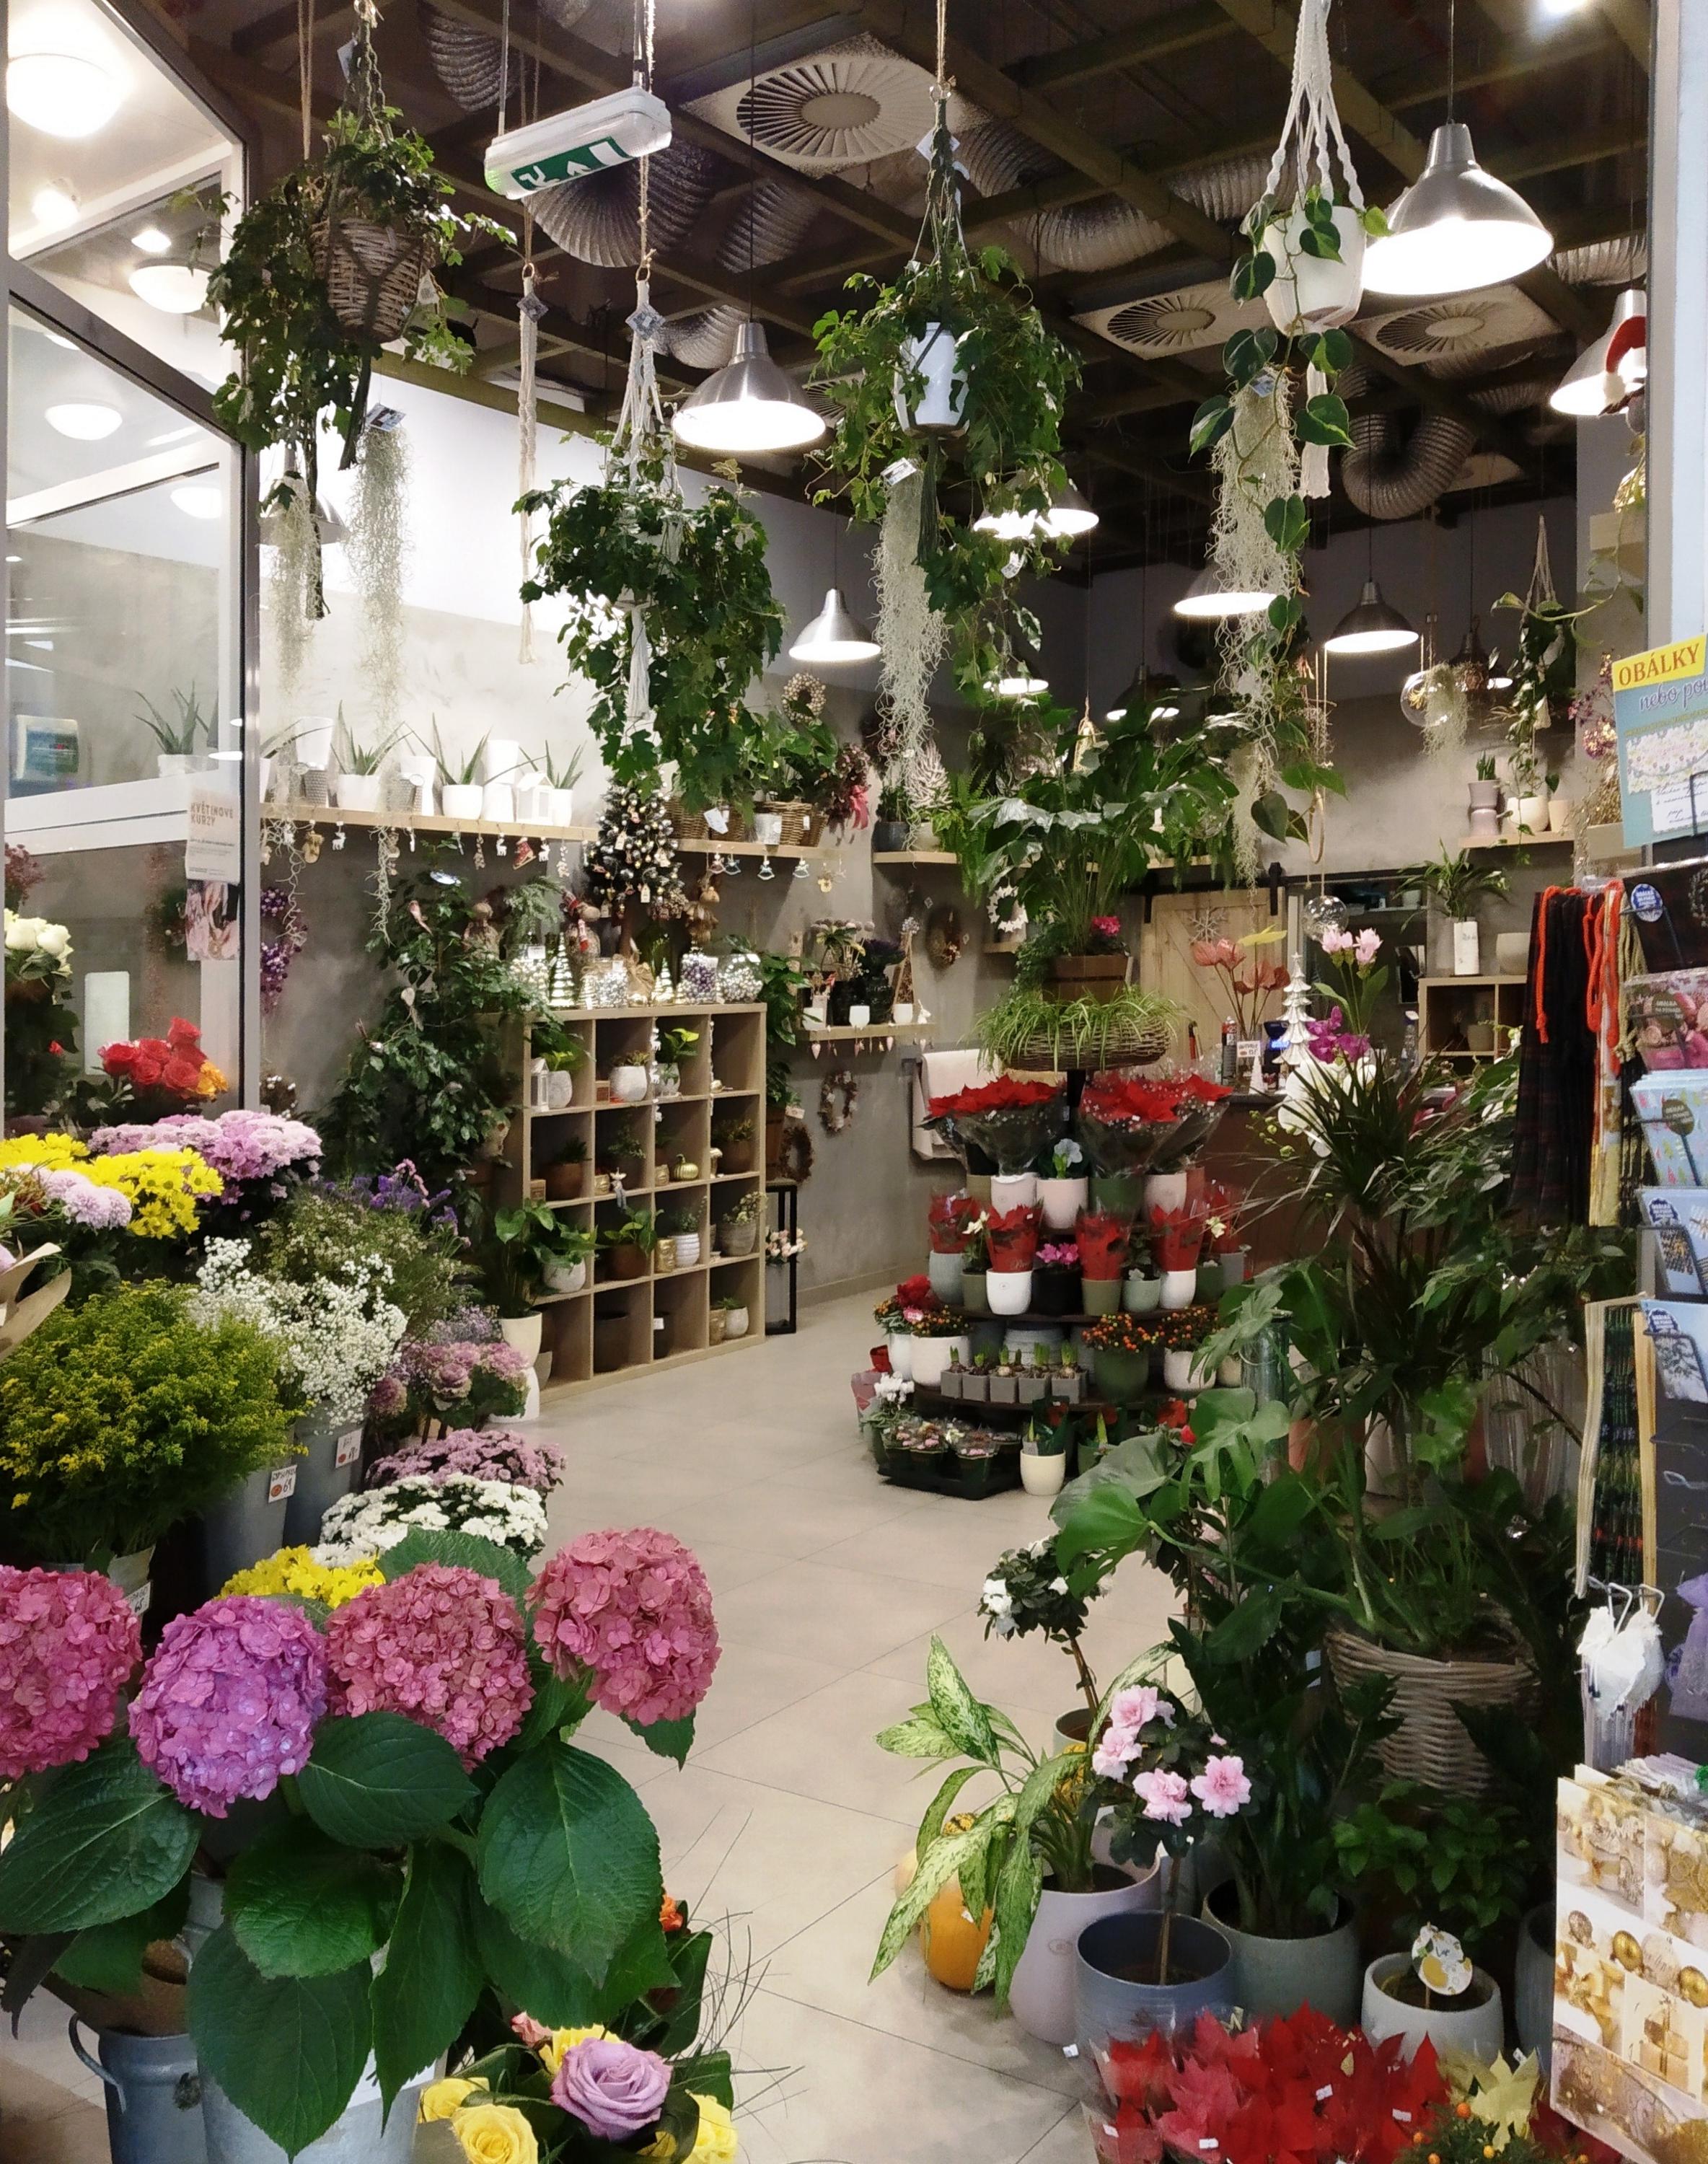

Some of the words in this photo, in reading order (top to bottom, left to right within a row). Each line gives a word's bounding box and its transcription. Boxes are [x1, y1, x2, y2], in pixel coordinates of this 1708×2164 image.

[1618, 642, 1700, 686] OBÁLKY
[1639, 683, 1679, 711] nebo
[190, 801, 234, 819] KVĚTINOVÉ
[190, 813, 216, 827] KURZY
